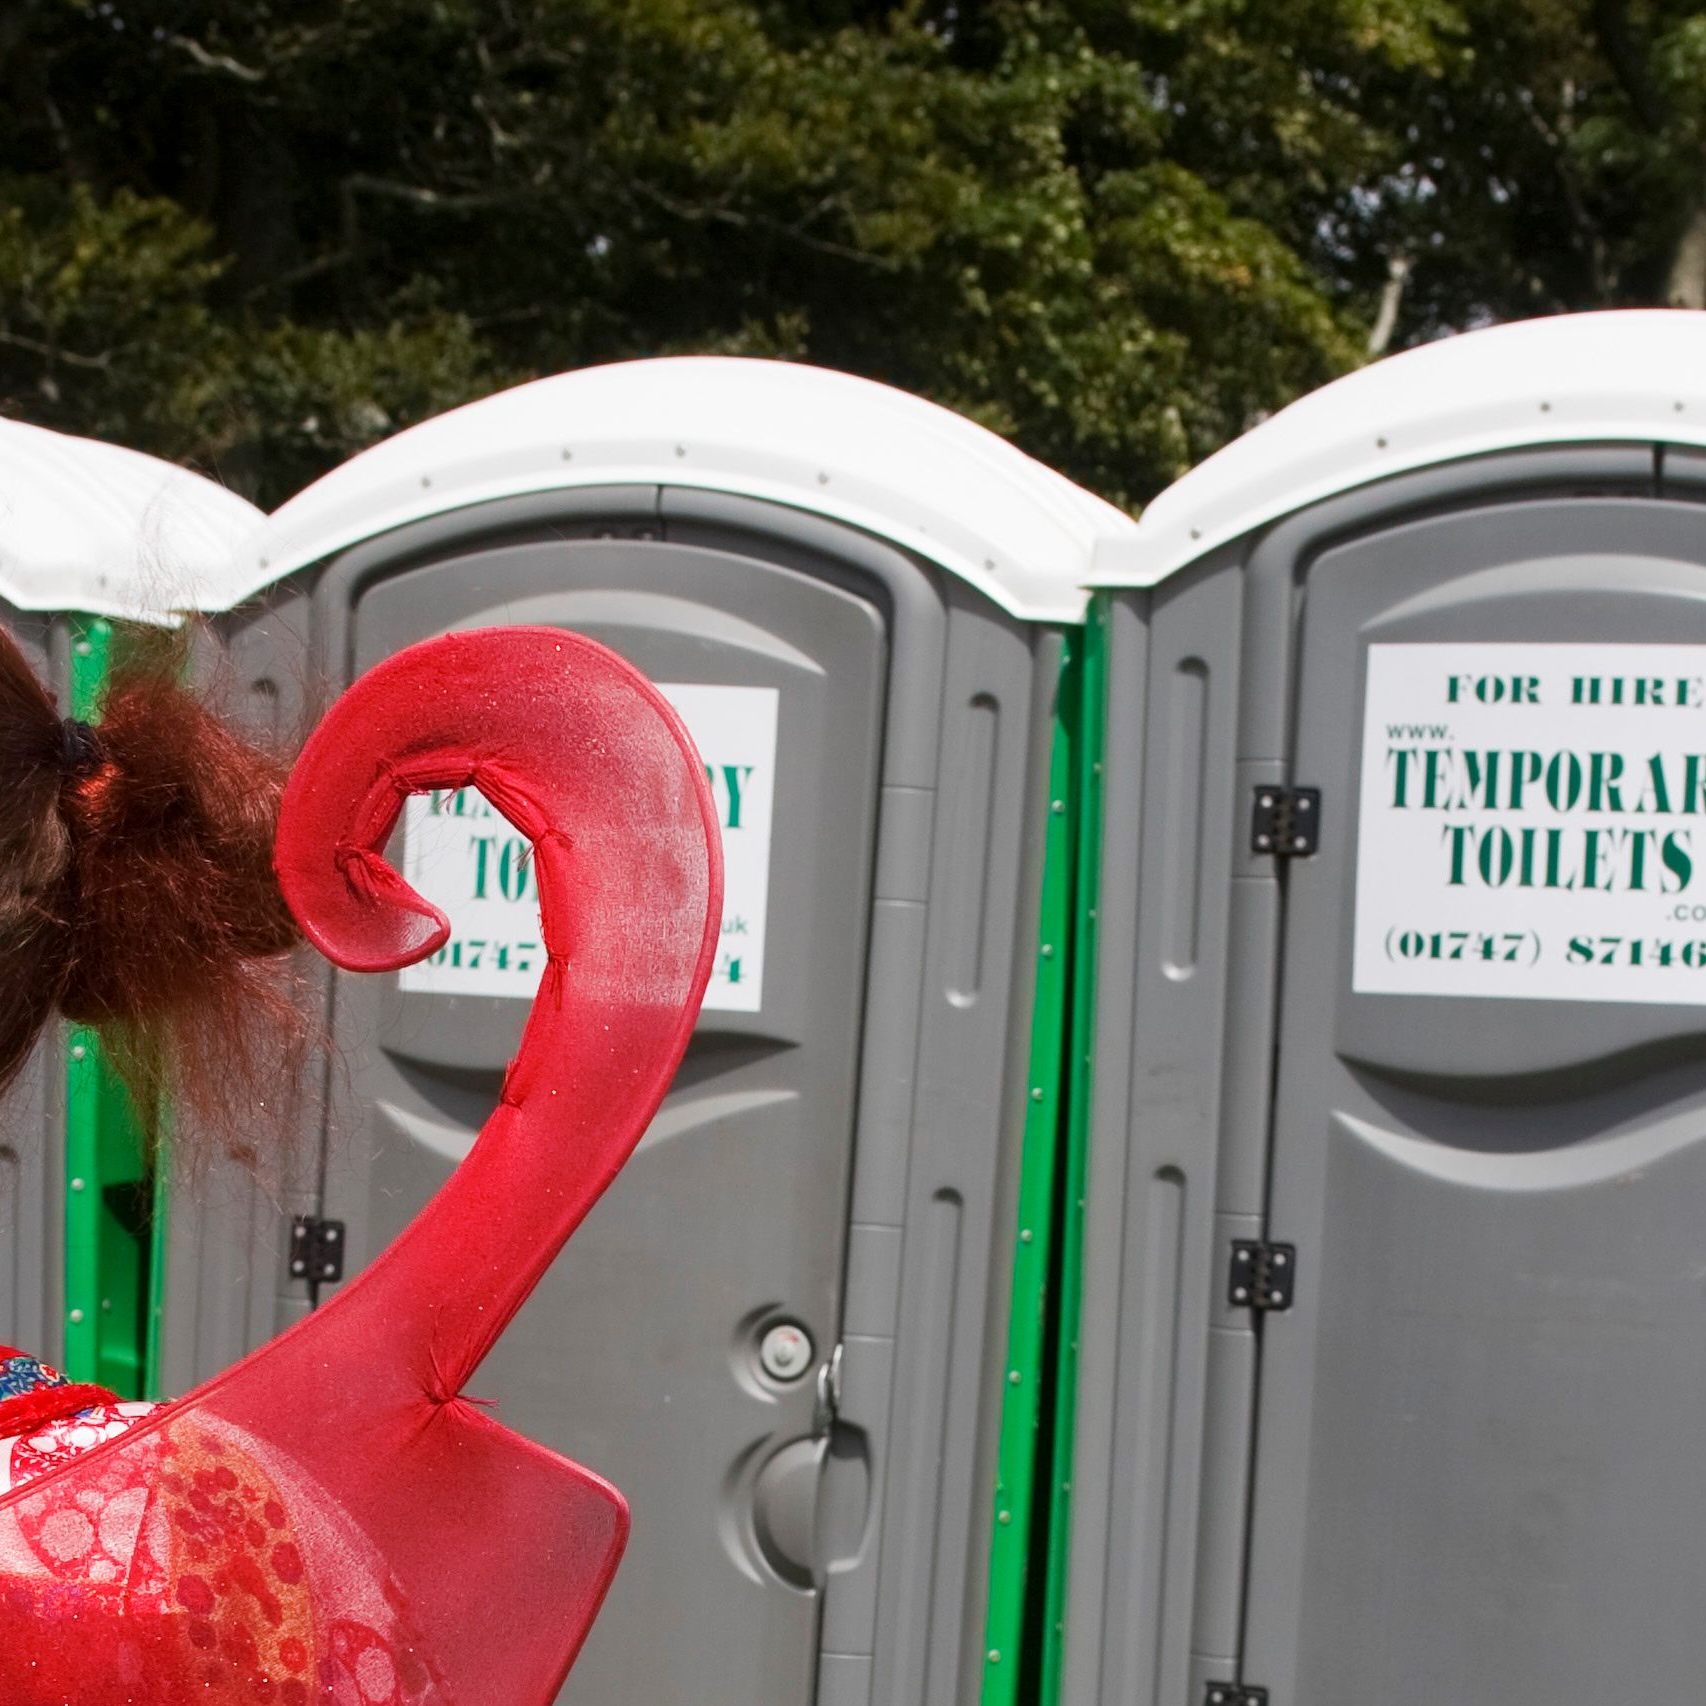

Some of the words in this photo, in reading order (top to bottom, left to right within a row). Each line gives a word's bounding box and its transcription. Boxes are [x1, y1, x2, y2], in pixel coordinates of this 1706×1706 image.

[1446, 674, 1542, 704] FOR
[1569, 676, 1705, 708] HIRE
[1386, 723, 1455, 742] www.
[1442, 823, 1695, 895] TOILETS
[1384, 925, 1543, 968] (01747)
